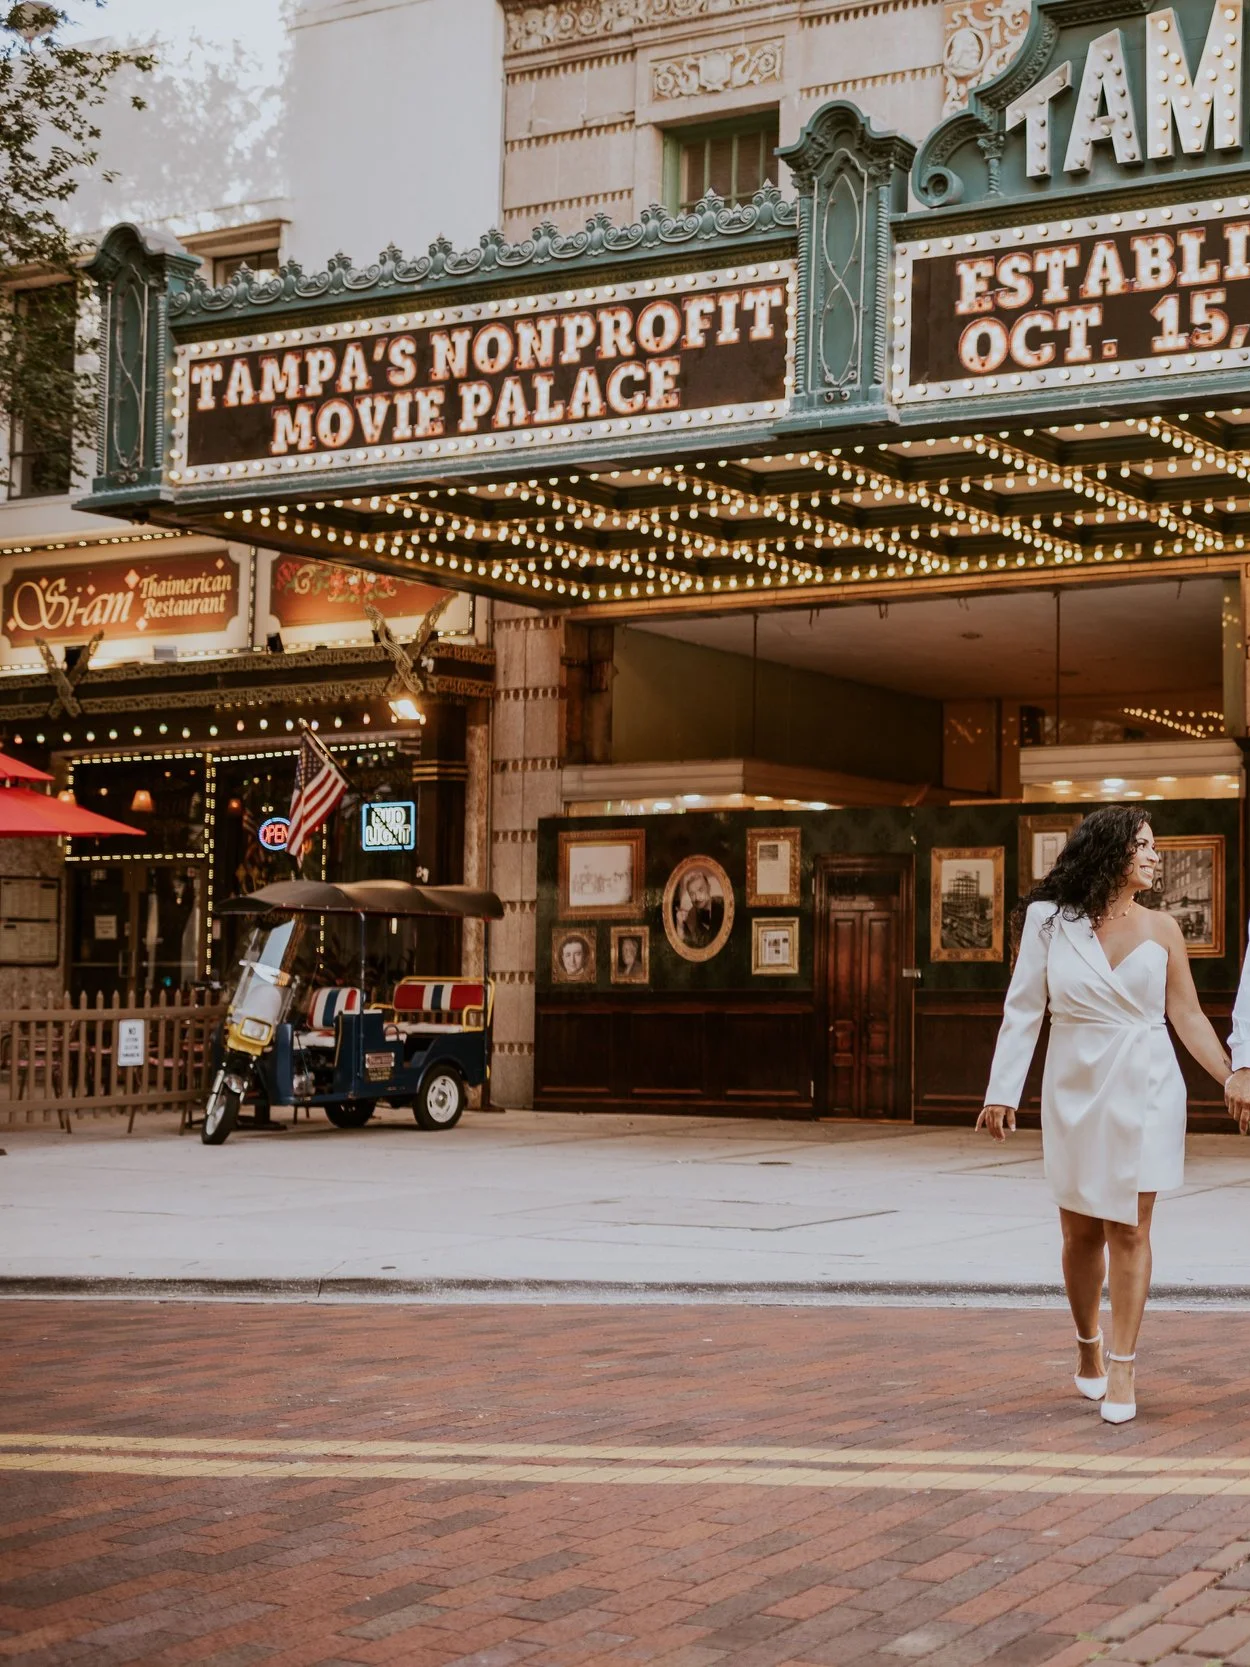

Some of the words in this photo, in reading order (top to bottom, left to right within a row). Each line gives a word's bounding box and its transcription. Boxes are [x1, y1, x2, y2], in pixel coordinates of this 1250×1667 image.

[189, 337, 417, 411] TAMPA'S
[430, 284, 785, 382] NONPROFIT
[957, 302, 1118, 374] OCT.
[269, 385, 446, 456] MOVIE
[458, 354, 683, 433] PALACE
[12, 577, 135, 631] Si-am
[139, 571, 232, 599] Thaimerican
[143, 593, 227, 619] Restaurant
[366, 824, 411, 846] LIGHT
[371, 806, 406, 826] BUD
